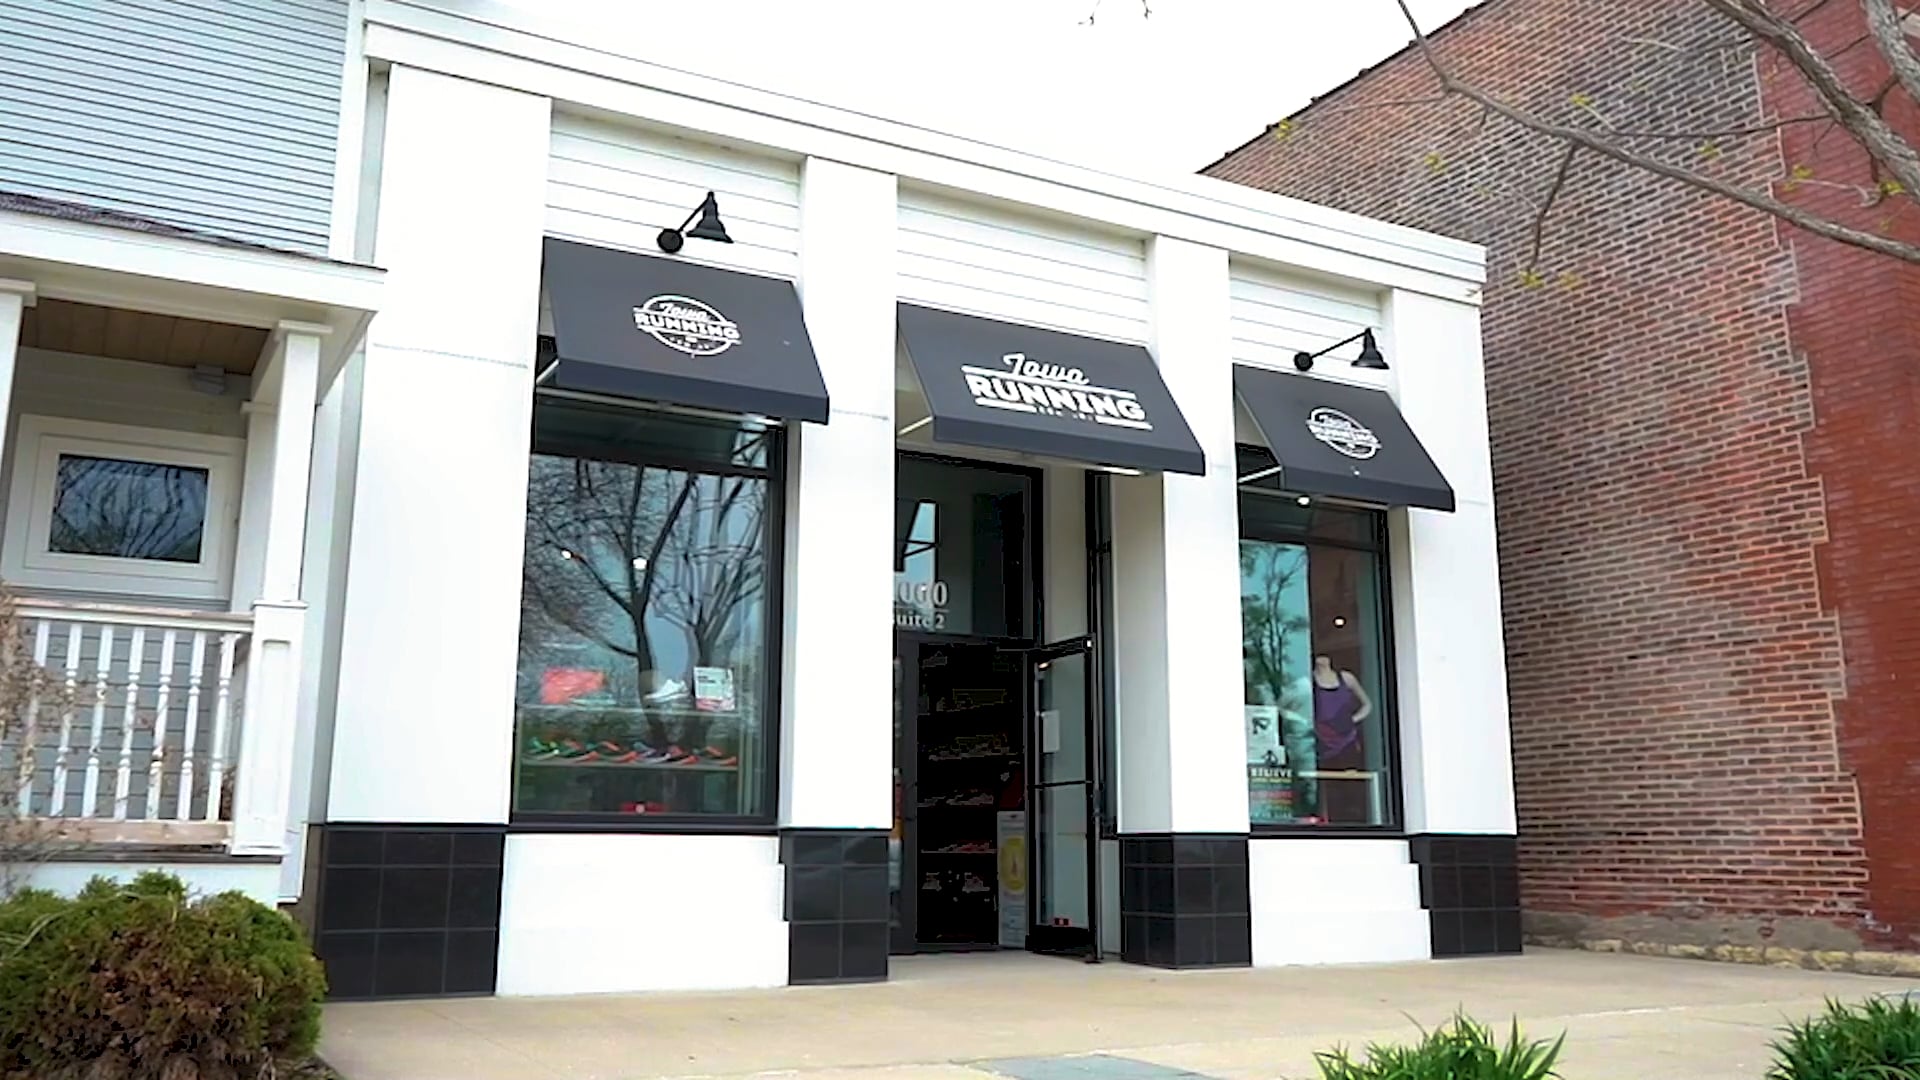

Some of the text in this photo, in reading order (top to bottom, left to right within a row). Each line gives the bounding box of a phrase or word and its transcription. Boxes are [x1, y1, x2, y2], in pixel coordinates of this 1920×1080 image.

[634, 312, 741, 340] RUNNING
[1003, 352, 1090, 385] Iowa
[964, 374, 1146, 420] RUNNING
[895, 610, 946, 629] uite 2
